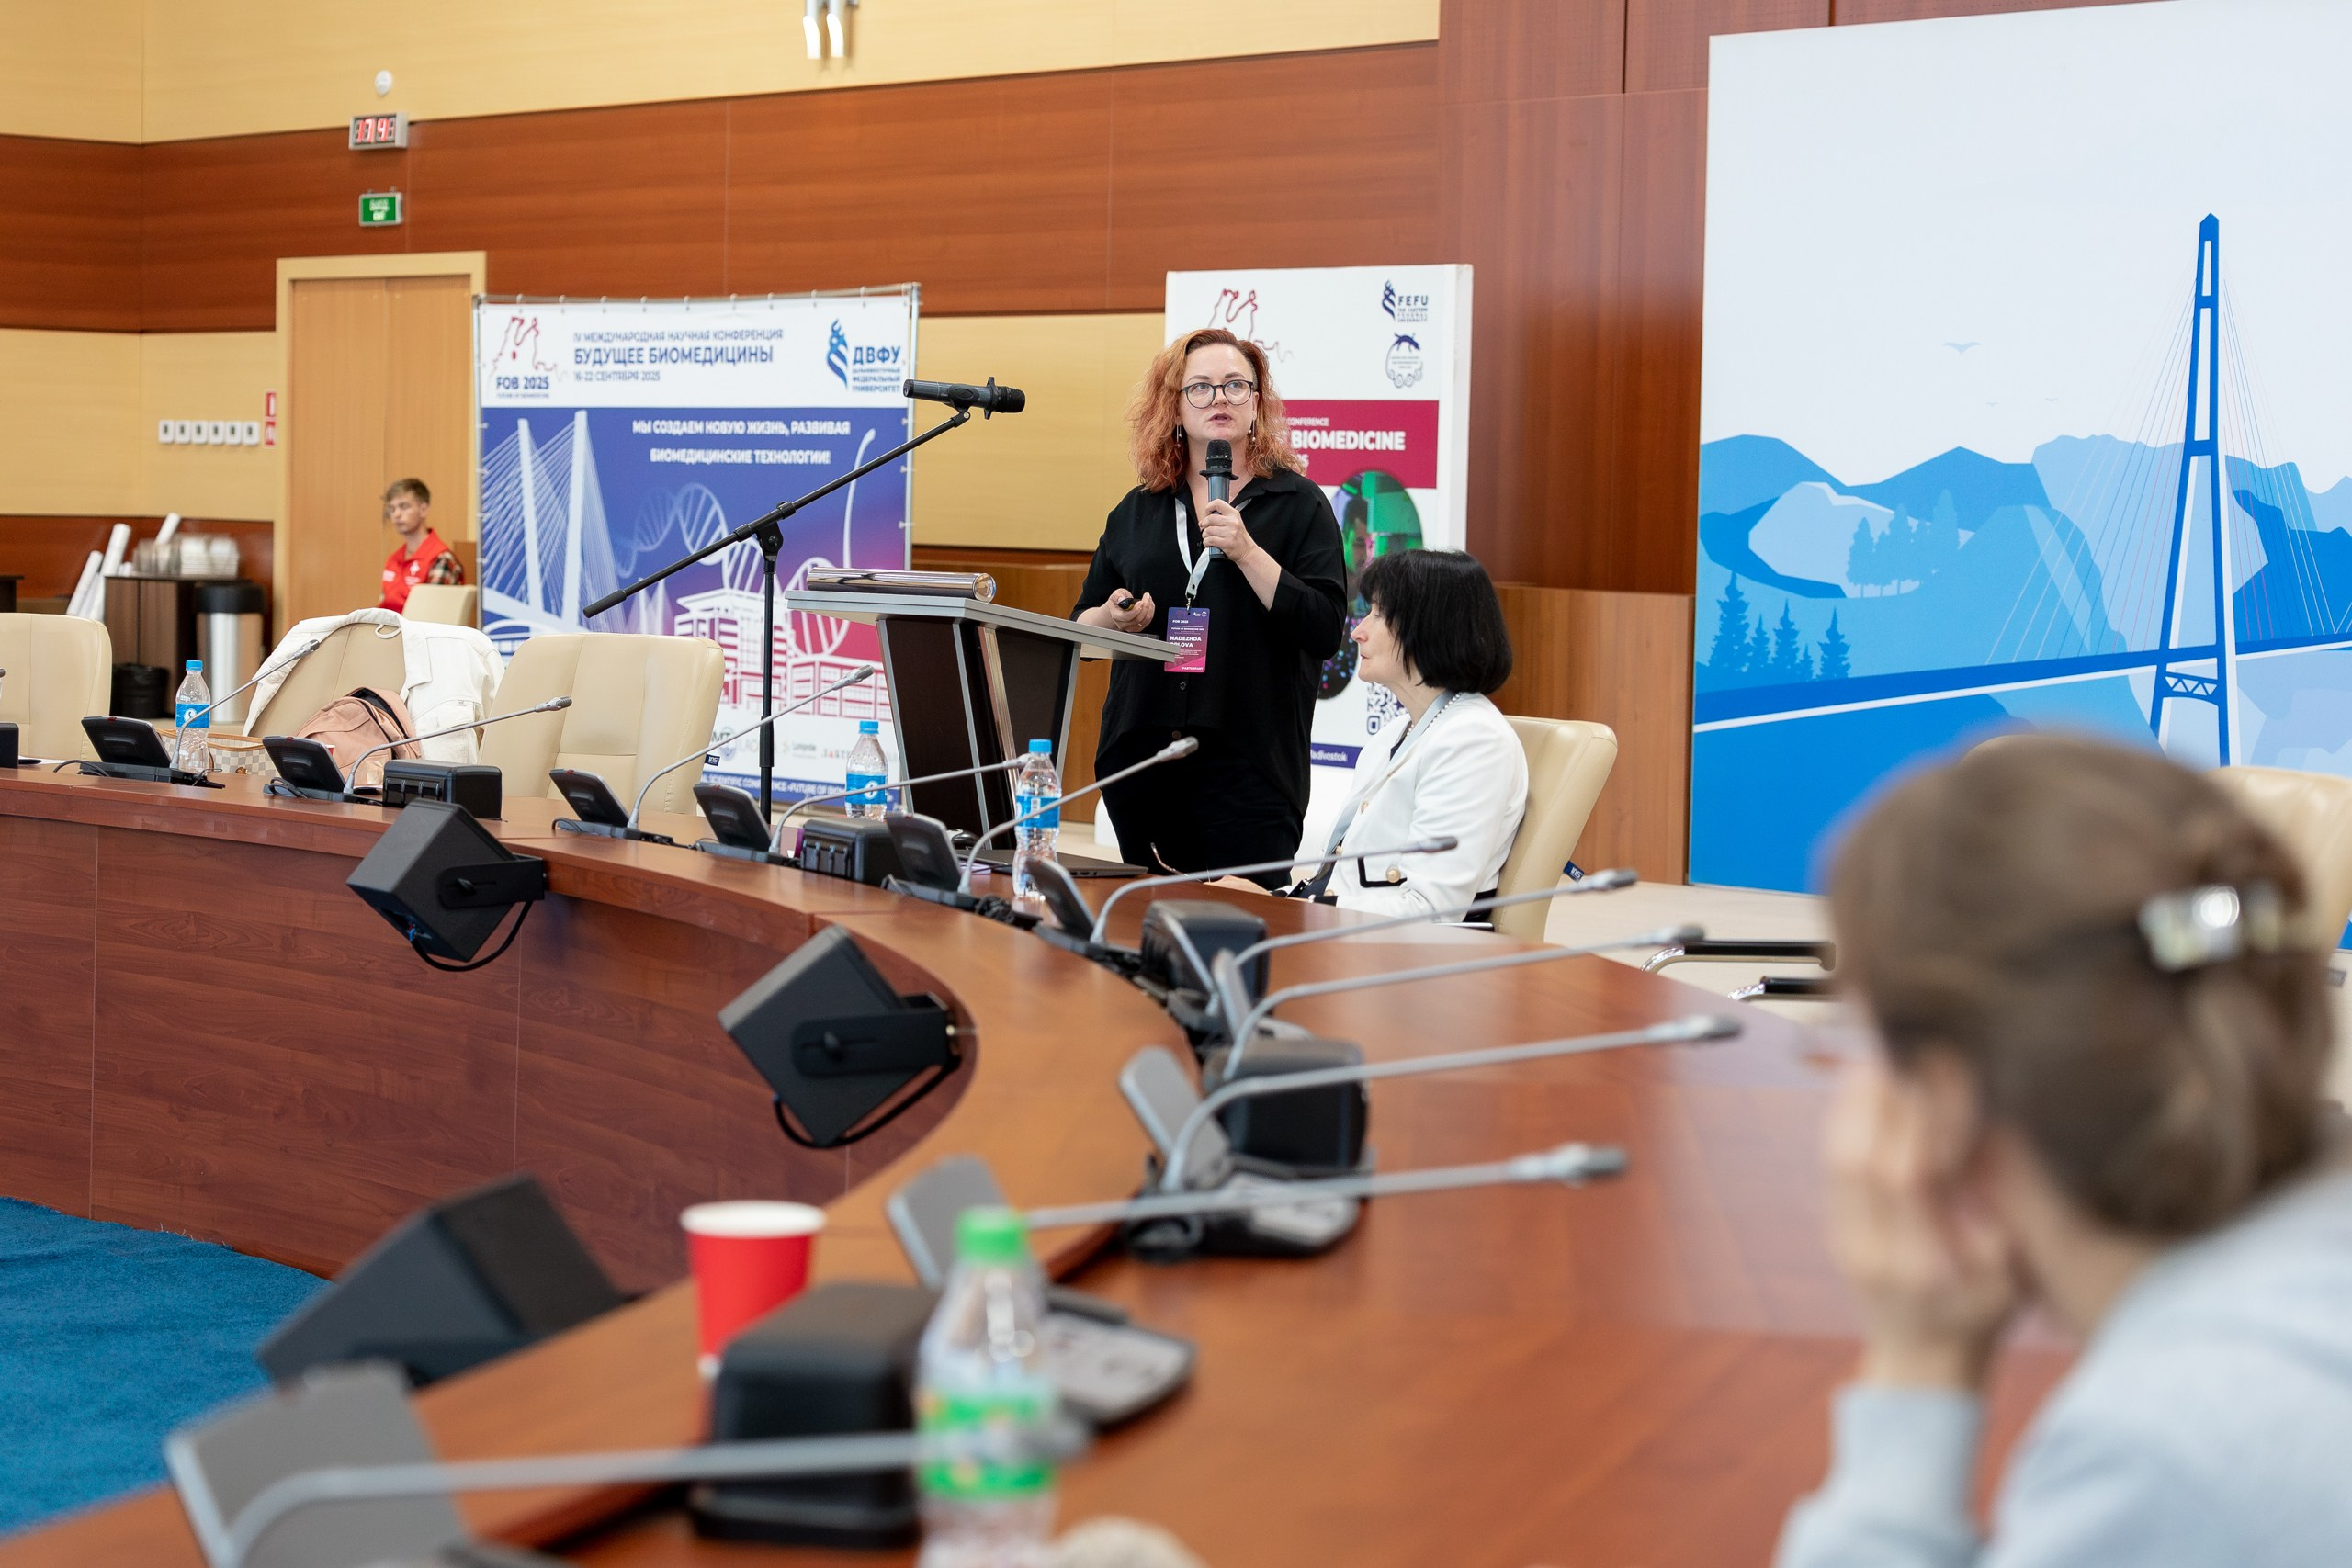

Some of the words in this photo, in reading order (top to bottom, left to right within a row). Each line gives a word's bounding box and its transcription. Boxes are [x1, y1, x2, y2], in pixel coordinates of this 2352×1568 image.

[1397, 295, 1429, 306] FEFU
[584, 332, 665, 343] МЕЖДУНАРОДНАЯ
[668, 331, 710, 341] НАУЧНАЯ
[713, 329, 784, 341] КОНФЕРЕНЦИЯ
[574, 347, 645, 367] БУДУЩЕЕ
[649, 345, 774, 367] БИОМЕДИЦИНЫ
[853, 346, 901, 365] ДВФУ
[496, 376, 519, 389] FOB
[523, 376, 549, 389] 2025
[595, 371, 639, 382] СЕНТЯБРЯ
[641, 371, 661, 382] 2025
[632, 420, 652, 434] МЫ
[653, 420, 704, 436] СОЗДАЕМ
[705, 421, 747, 435] НОВУЮ
[747, 421, 790, 436] ЖИЗНЬ,
[791, 421, 851, 435] РАЗВИВАЯ
[1291, 429, 1407, 451] BIOMEDICINE
[650, 448, 753, 465] БИОМЕДИЦИНСКИЕ
